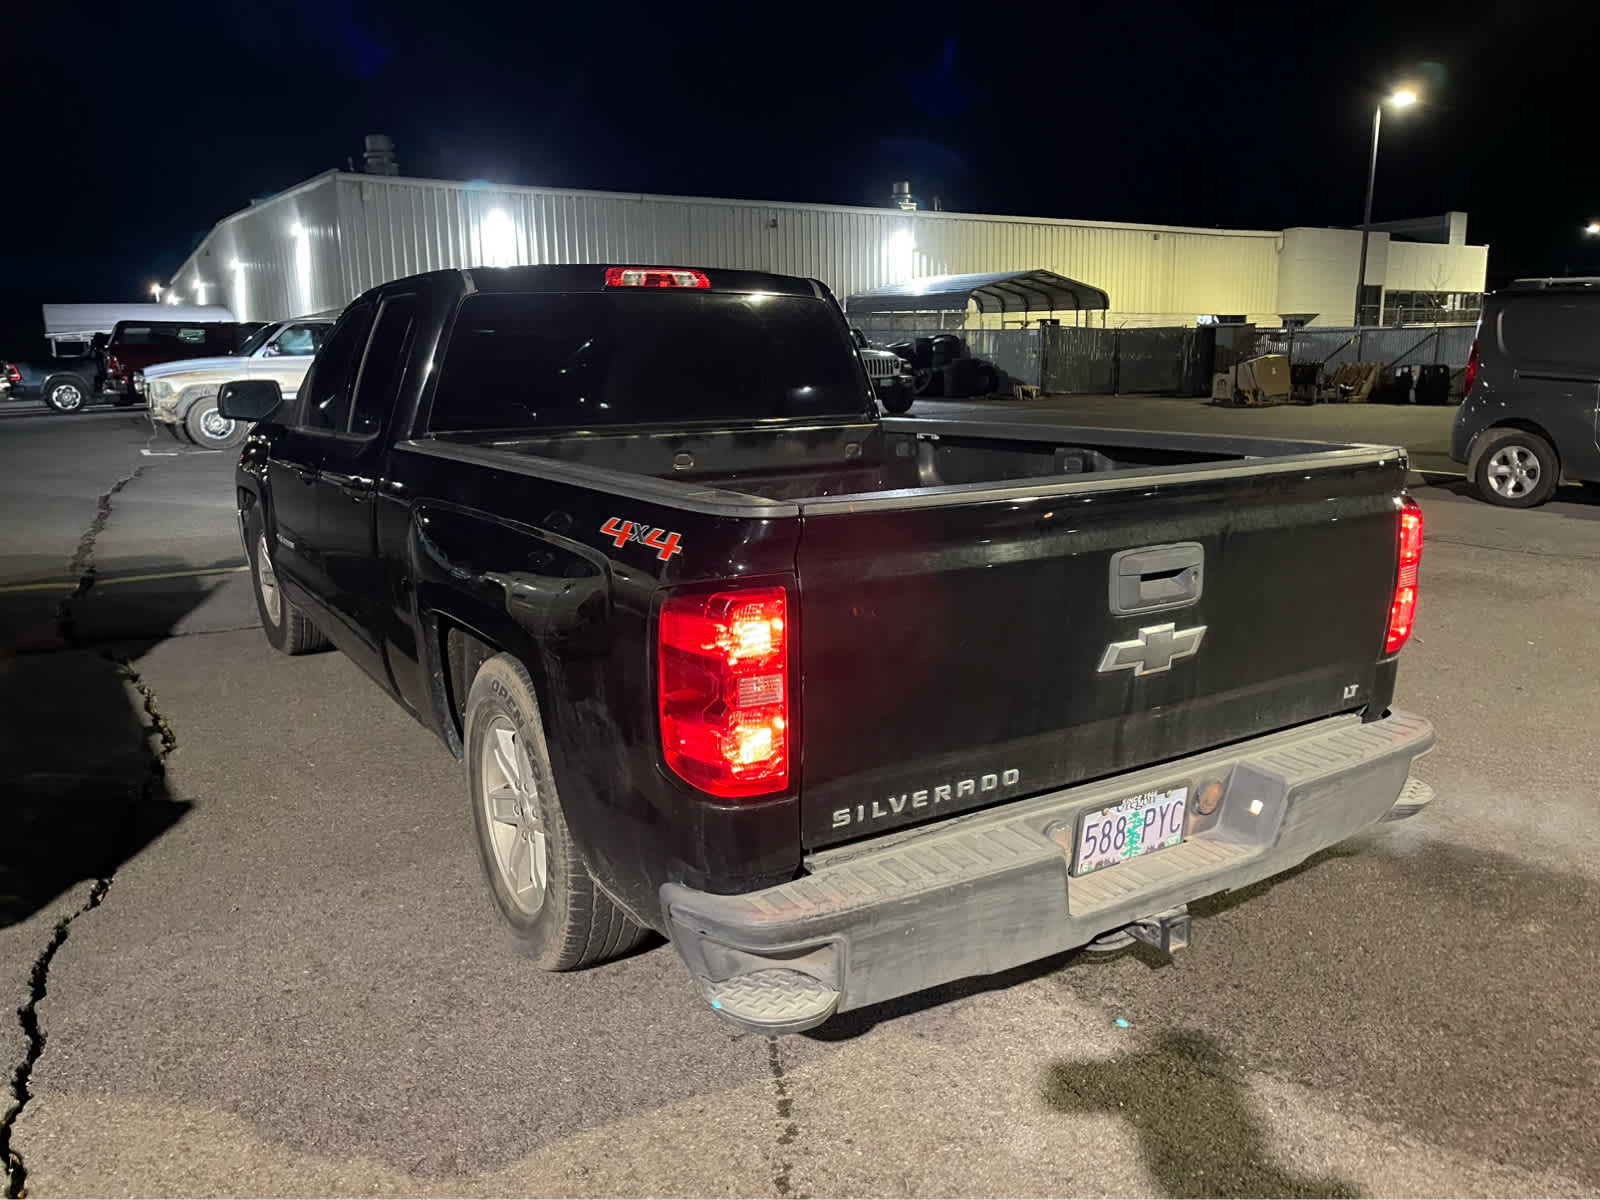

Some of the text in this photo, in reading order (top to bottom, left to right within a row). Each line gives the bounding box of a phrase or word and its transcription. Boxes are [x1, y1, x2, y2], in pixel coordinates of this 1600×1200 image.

[491, 679, 525, 729] OPEN
[1343, 684, 1359, 699] LT
[832, 768, 1020, 828] SILVERADO
[1083, 800, 1184, 860] 588 PYC
